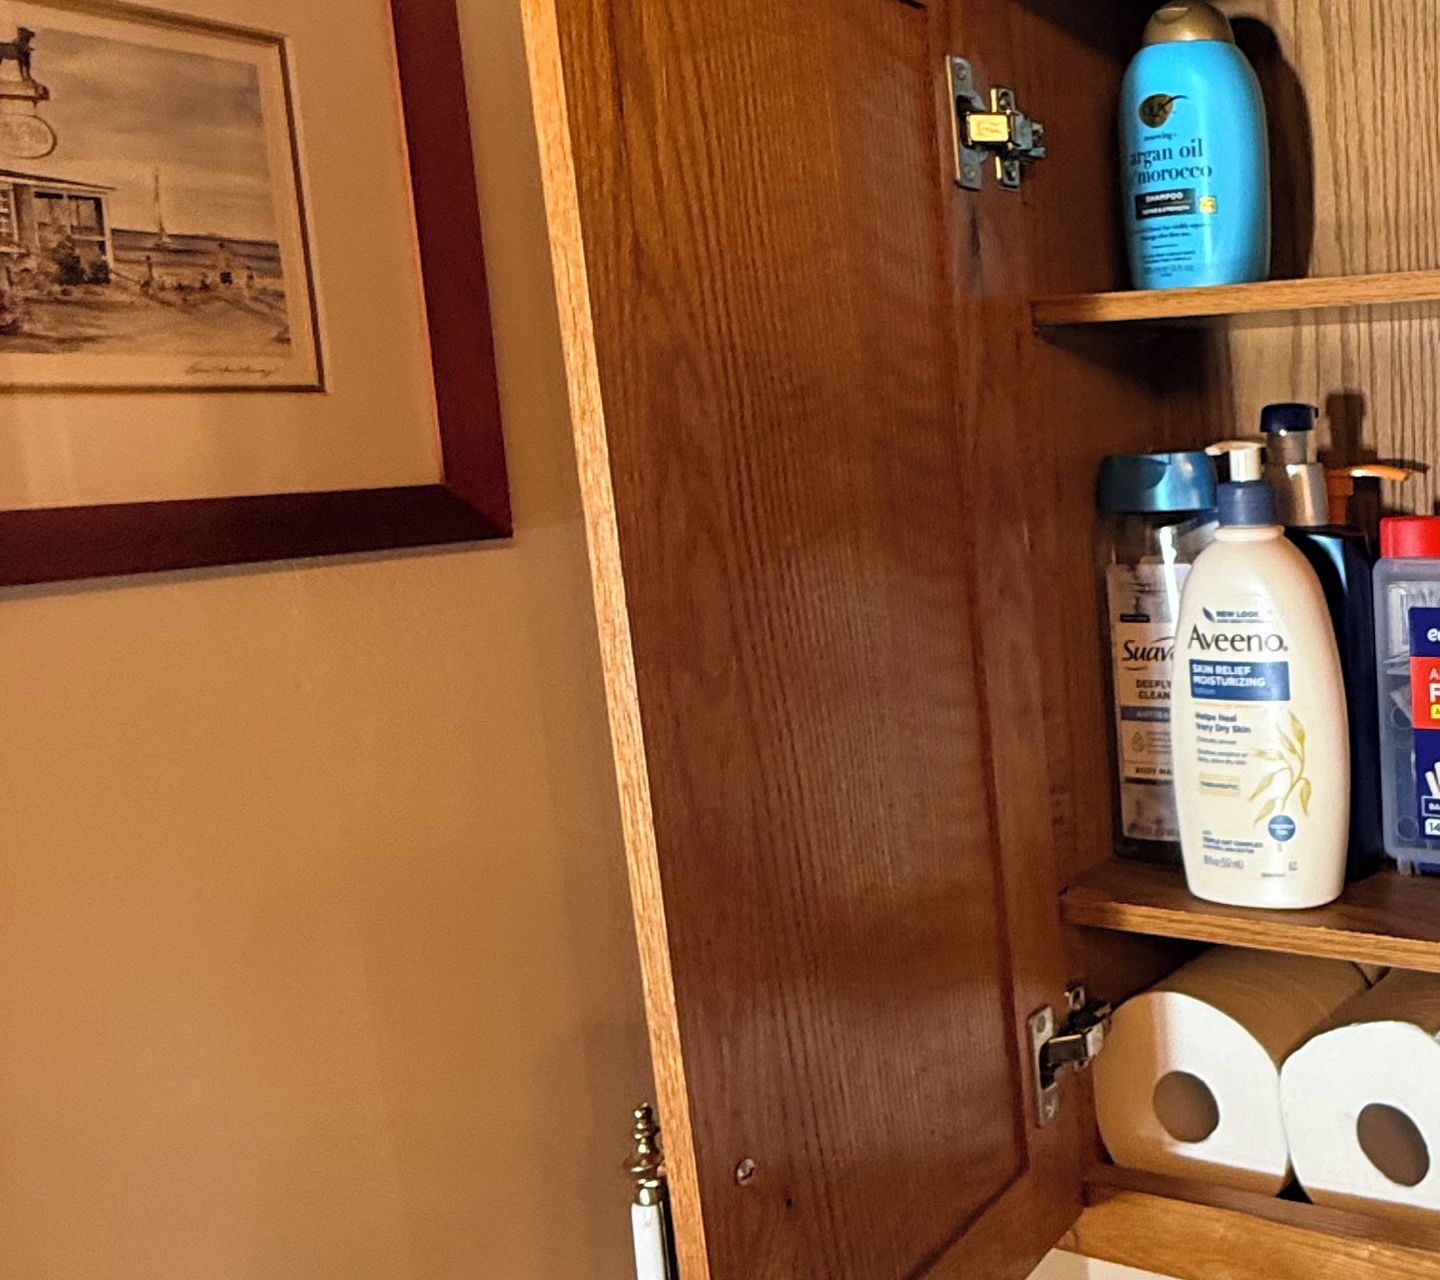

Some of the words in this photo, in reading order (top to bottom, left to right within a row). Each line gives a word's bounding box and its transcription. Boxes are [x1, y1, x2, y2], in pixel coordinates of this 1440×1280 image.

[1130, 147, 1173, 169] argan
[1179, 138, 1203, 158] oil
[1138, 165, 1213, 184] morocco
[1145, 192, 1183, 203] SHAMPOO
[1188, 624, 1285, 651] Aveeno
[1192, 664, 1213, 673] SKIN
[1215, 665, 1251, 674] RELIEF
[1193, 675, 1266, 687] MOISTURIZING
[1138, 691, 1170, 700] CLEAN
[1195, 712, 1216, 721] Helps
[1218, 713, 1237, 722] Heal
[1196, 722, 1213, 732] Very
[1215, 724, 1230, 734] Dry
[1232, 725, 1251, 733] Skin
